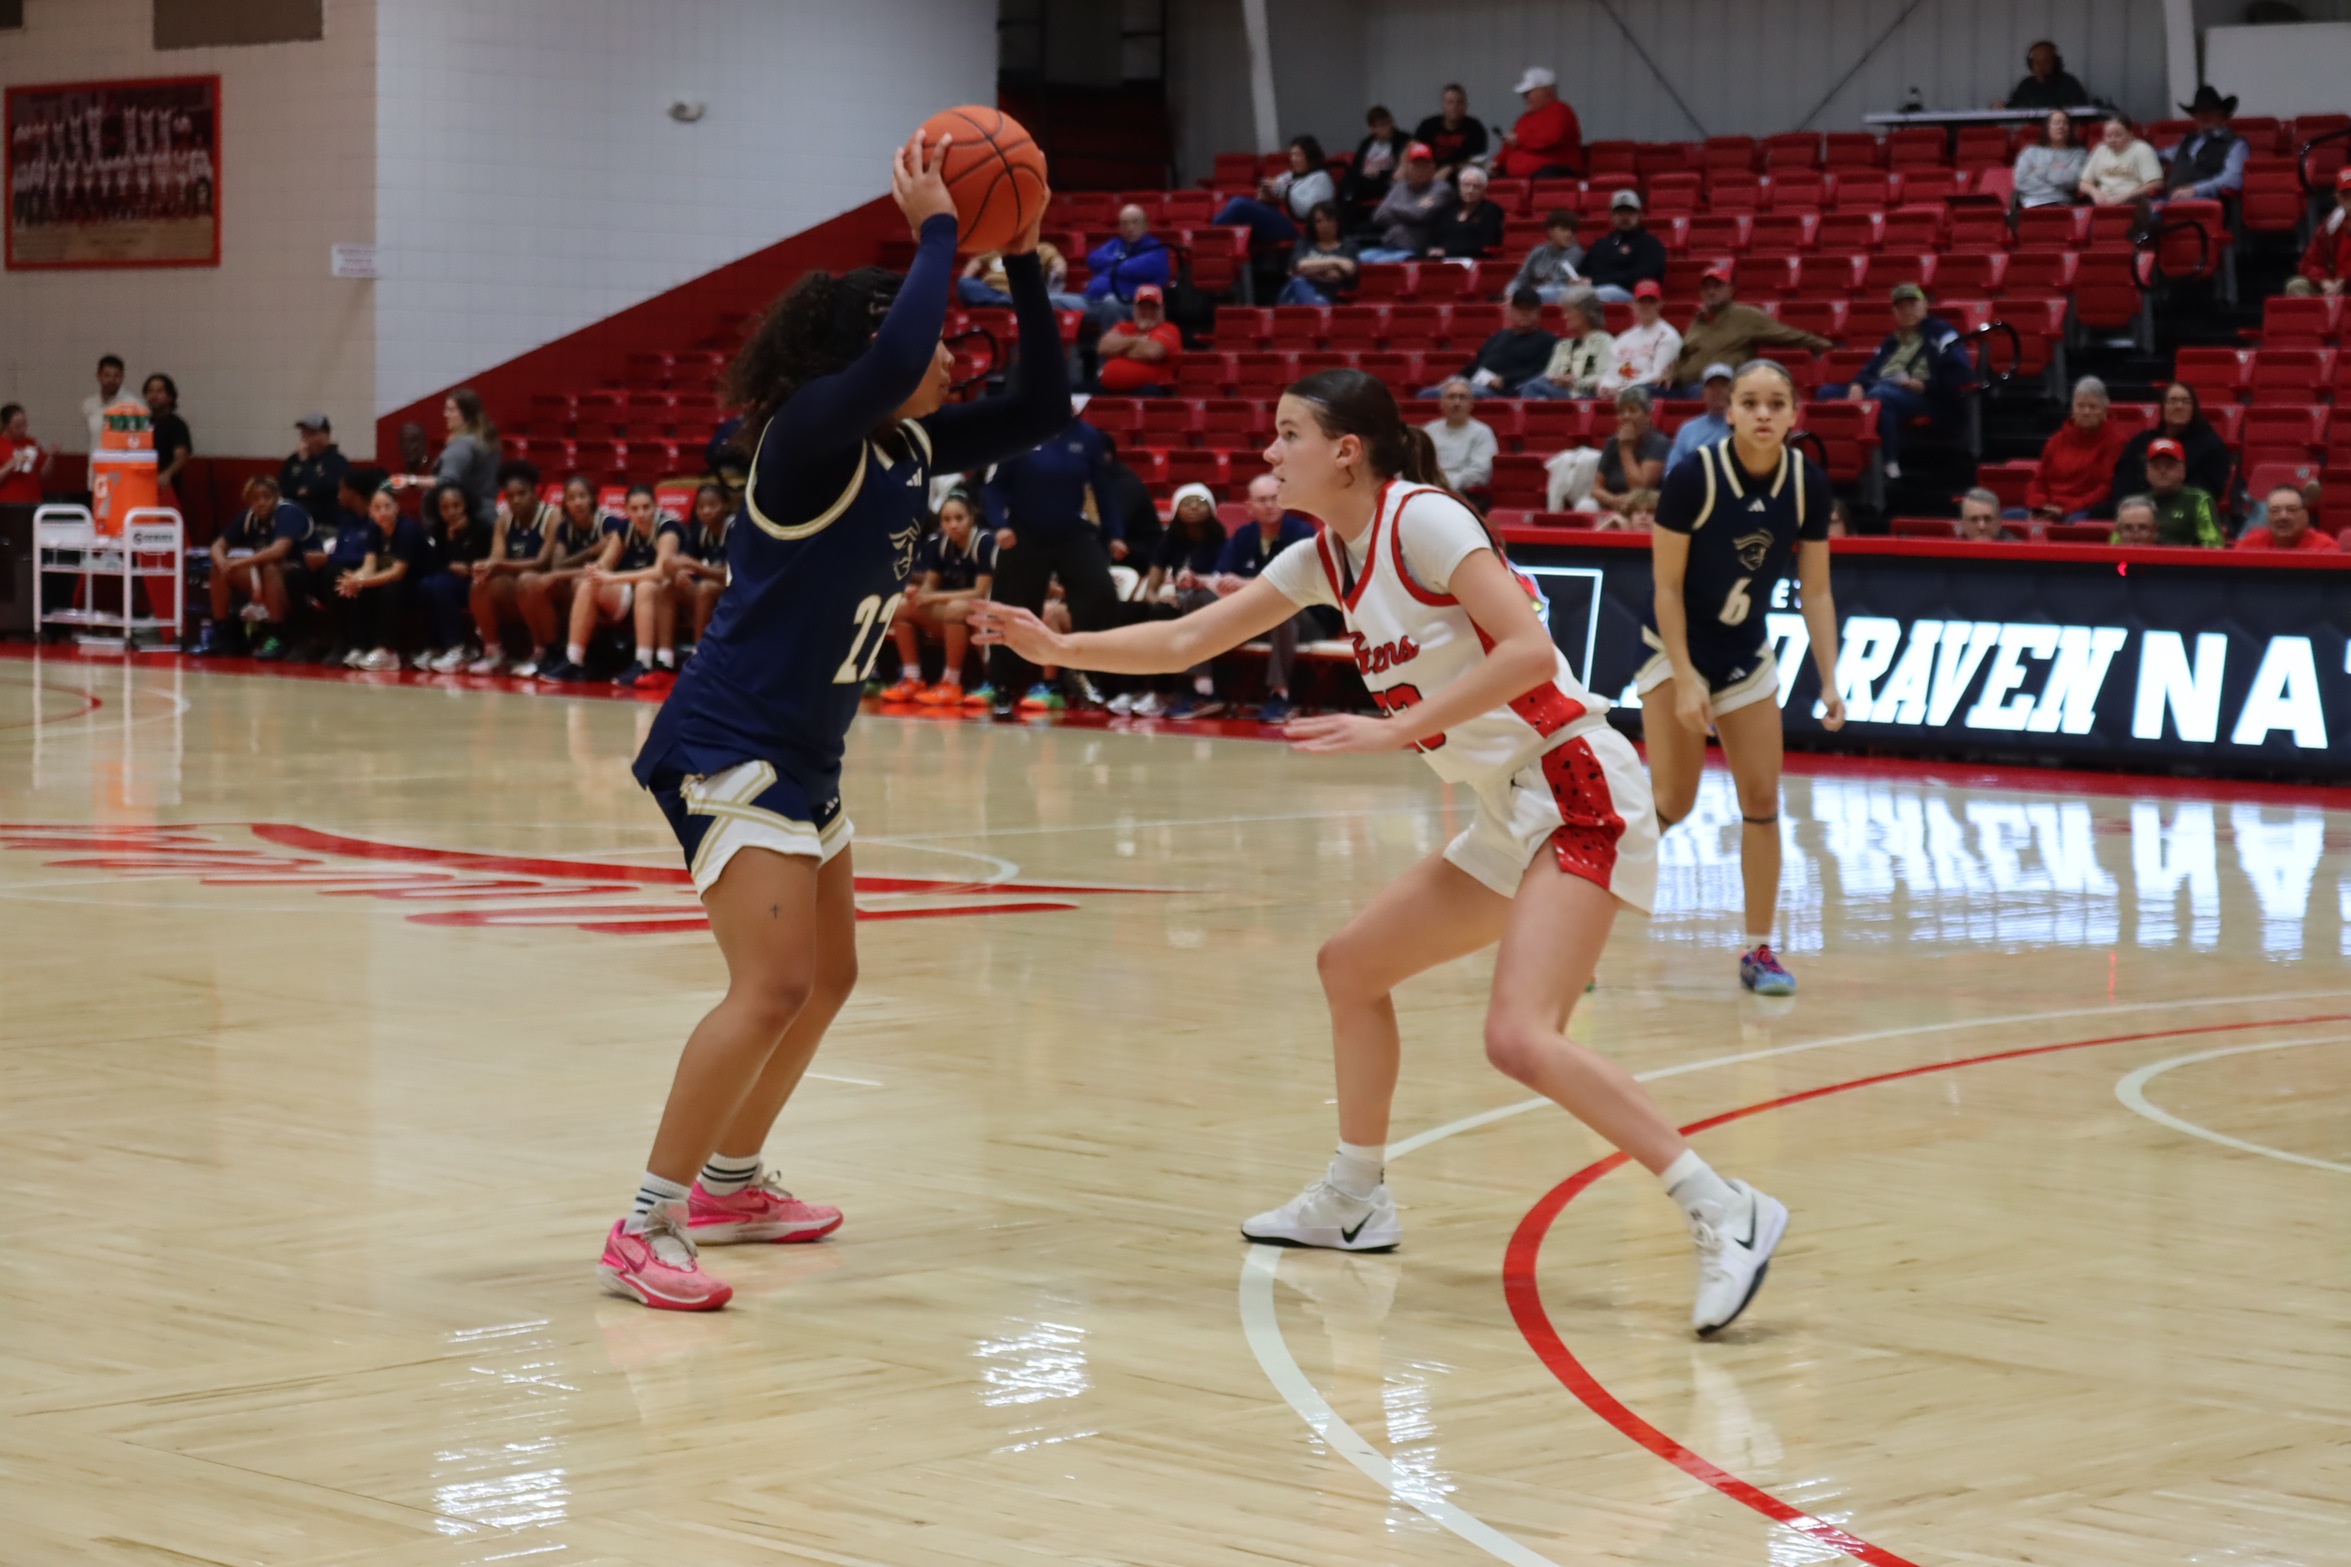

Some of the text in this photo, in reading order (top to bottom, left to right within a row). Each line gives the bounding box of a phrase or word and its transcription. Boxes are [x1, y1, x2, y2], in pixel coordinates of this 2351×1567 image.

[1718, 577, 1752, 626] 6
[1811, 615, 2129, 736] RAVEN
[2131, 629, 2351, 750] NA
